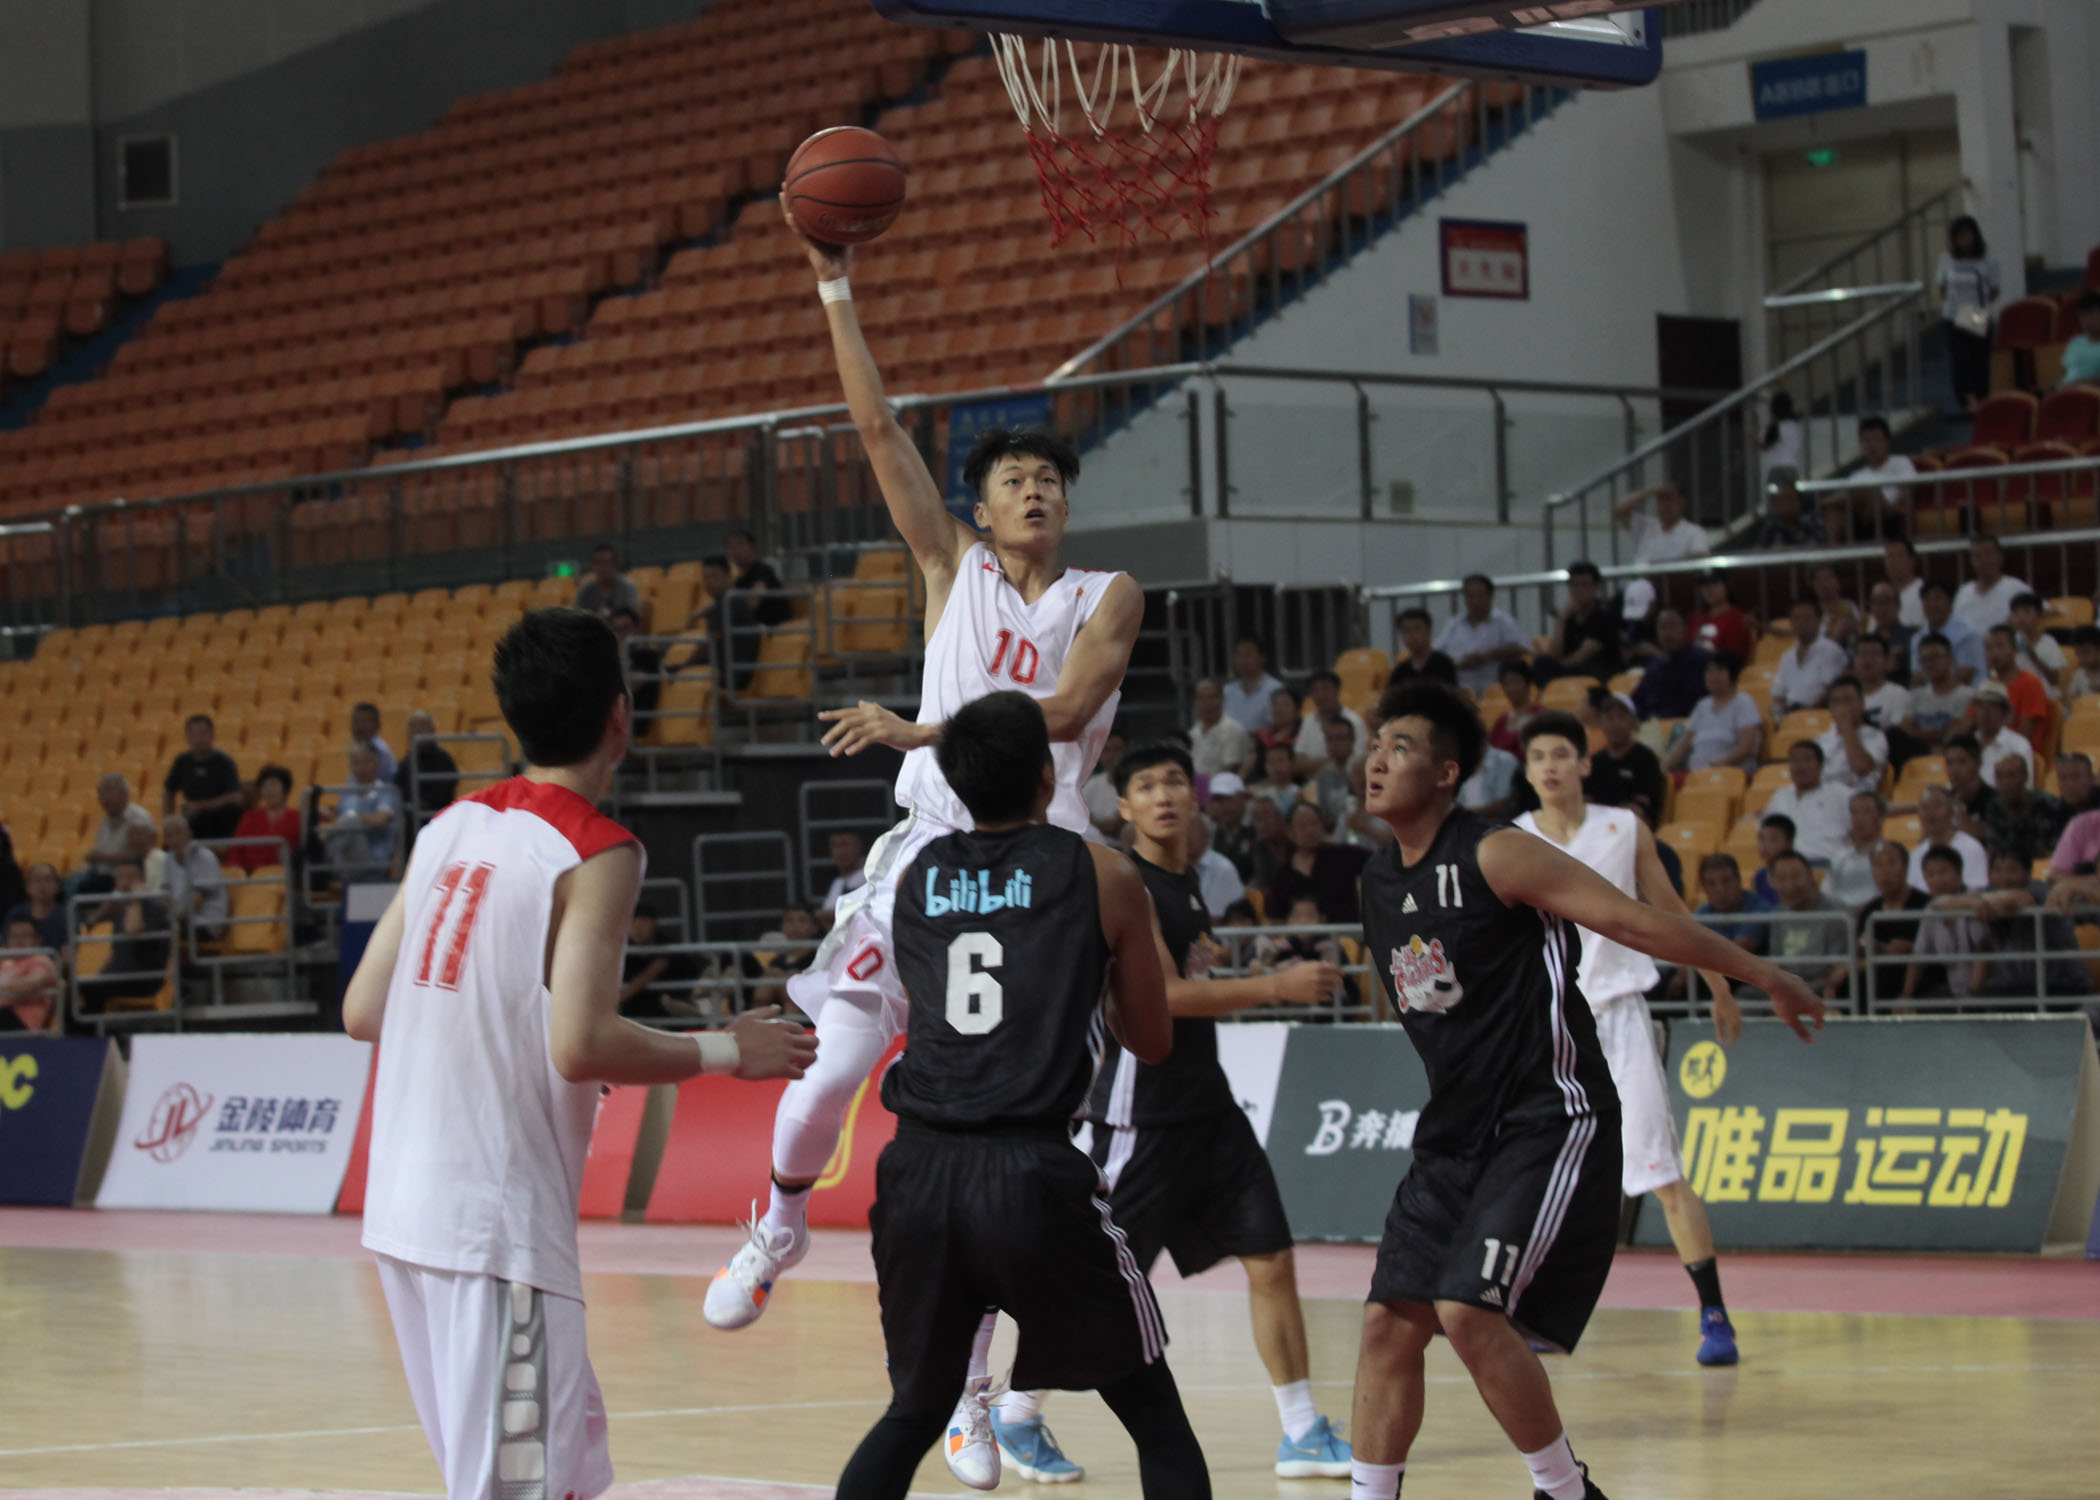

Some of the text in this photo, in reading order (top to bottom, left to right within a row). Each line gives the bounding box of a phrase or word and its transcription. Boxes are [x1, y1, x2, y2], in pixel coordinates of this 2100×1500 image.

[987, 627, 1039, 688] 10
[924, 864, 1033, 917] bilibili
[1434, 863, 1464, 908] 11
[413, 860, 498, 993] 11
[944, 931, 1004, 1036] 6
[1681, 1106, 2029, 1208] 唯品运动
[1480, 1237, 1520, 1287] 11
